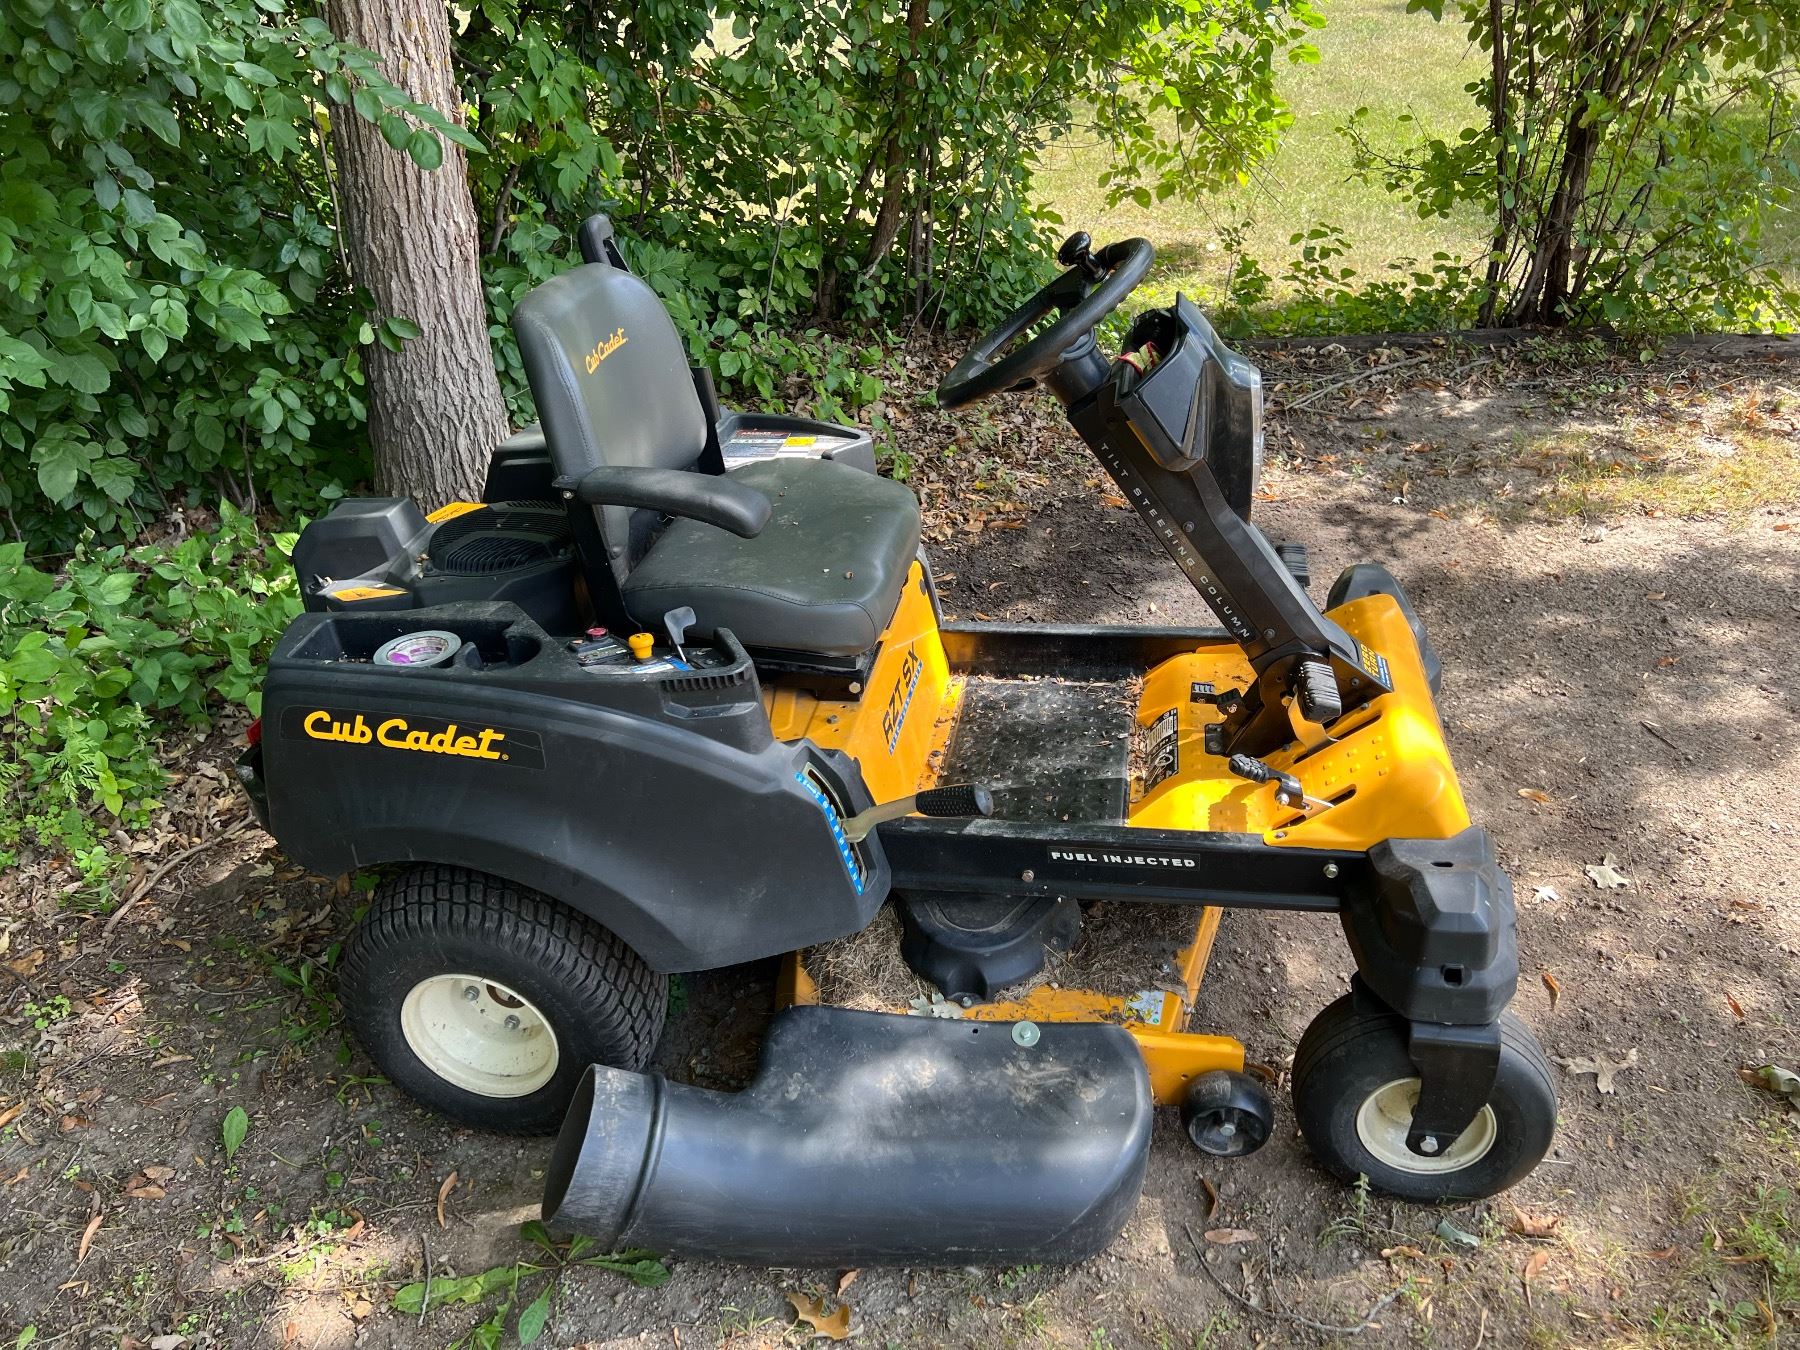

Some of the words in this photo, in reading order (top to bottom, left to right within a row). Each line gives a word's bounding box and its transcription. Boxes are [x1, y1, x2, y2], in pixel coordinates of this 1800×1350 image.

[585, 348, 600, 375] Cub
[597, 327, 625, 361] Cadet
[1101, 442, 1129, 478] TILT
[1133, 487, 1195, 567] STEERING
[1200, 575, 1250, 638] COLUMN
[1360, 643, 1372, 673] ZERO
[1368, 648, 1380, 678] TURN
[883, 677, 903, 744] RZT
[902, 641, 919, 688] SX
[303, 710, 373, 745] Cub
[376, 718, 505, 761] Cadet
[1051, 851, 1098, 862] FUEL
[1103, 854, 1196, 868] INJECTED
